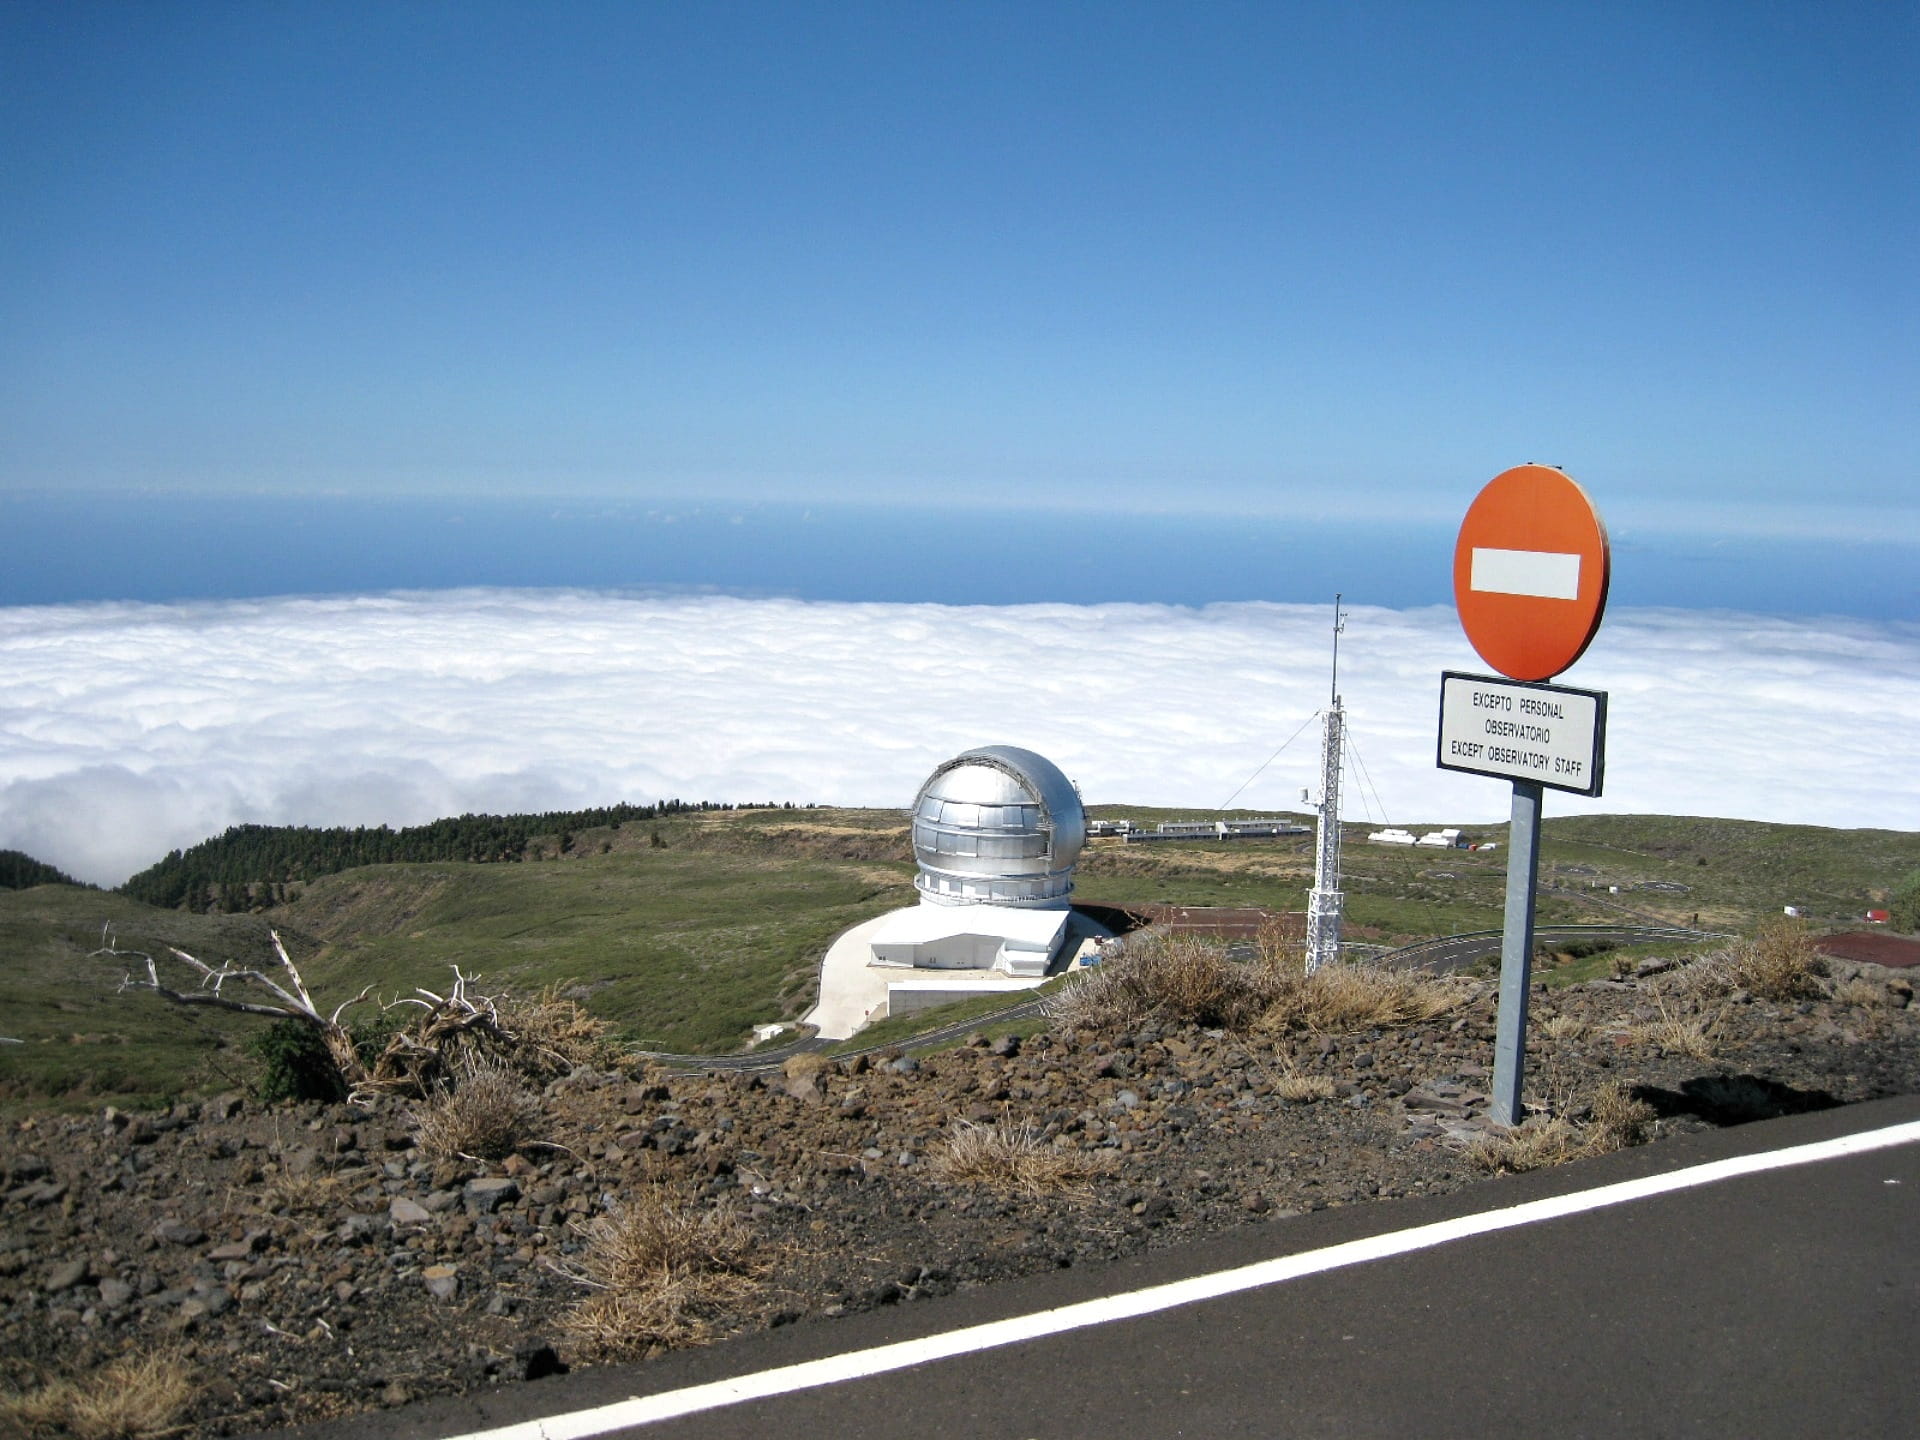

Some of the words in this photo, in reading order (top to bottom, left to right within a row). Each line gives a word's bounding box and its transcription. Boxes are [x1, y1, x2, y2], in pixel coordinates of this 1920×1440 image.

[1473, 692, 1512, 712] EXCEPTO
[1520, 698, 1564, 720] PERSONAL
[1485, 719, 1550, 744] OBSERVATORIO
[1451, 740, 1484, 759] EXCEPT
[1488, 747, 1550, 772] OBSERVATORY
[1555, 757, 1582, 777] STAFF
